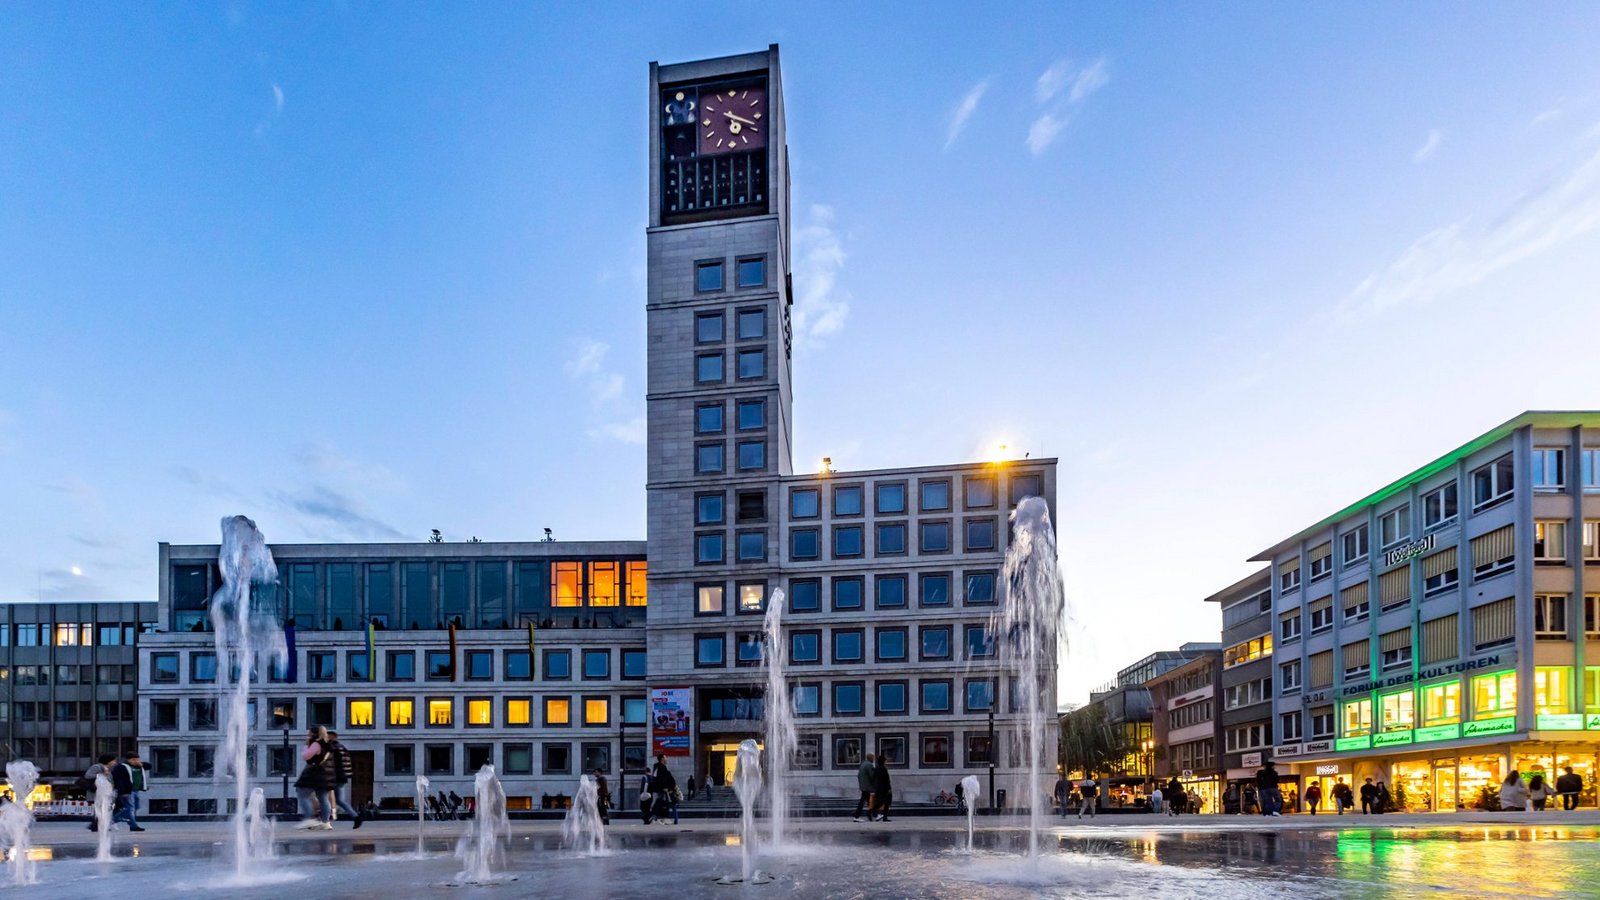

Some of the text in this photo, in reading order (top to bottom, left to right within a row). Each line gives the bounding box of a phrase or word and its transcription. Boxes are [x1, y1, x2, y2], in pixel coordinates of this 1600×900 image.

[1343, 655, 1499, 696] FORUM DER KULTUREN
[1464, 723, 1513, 735] Schumacher
